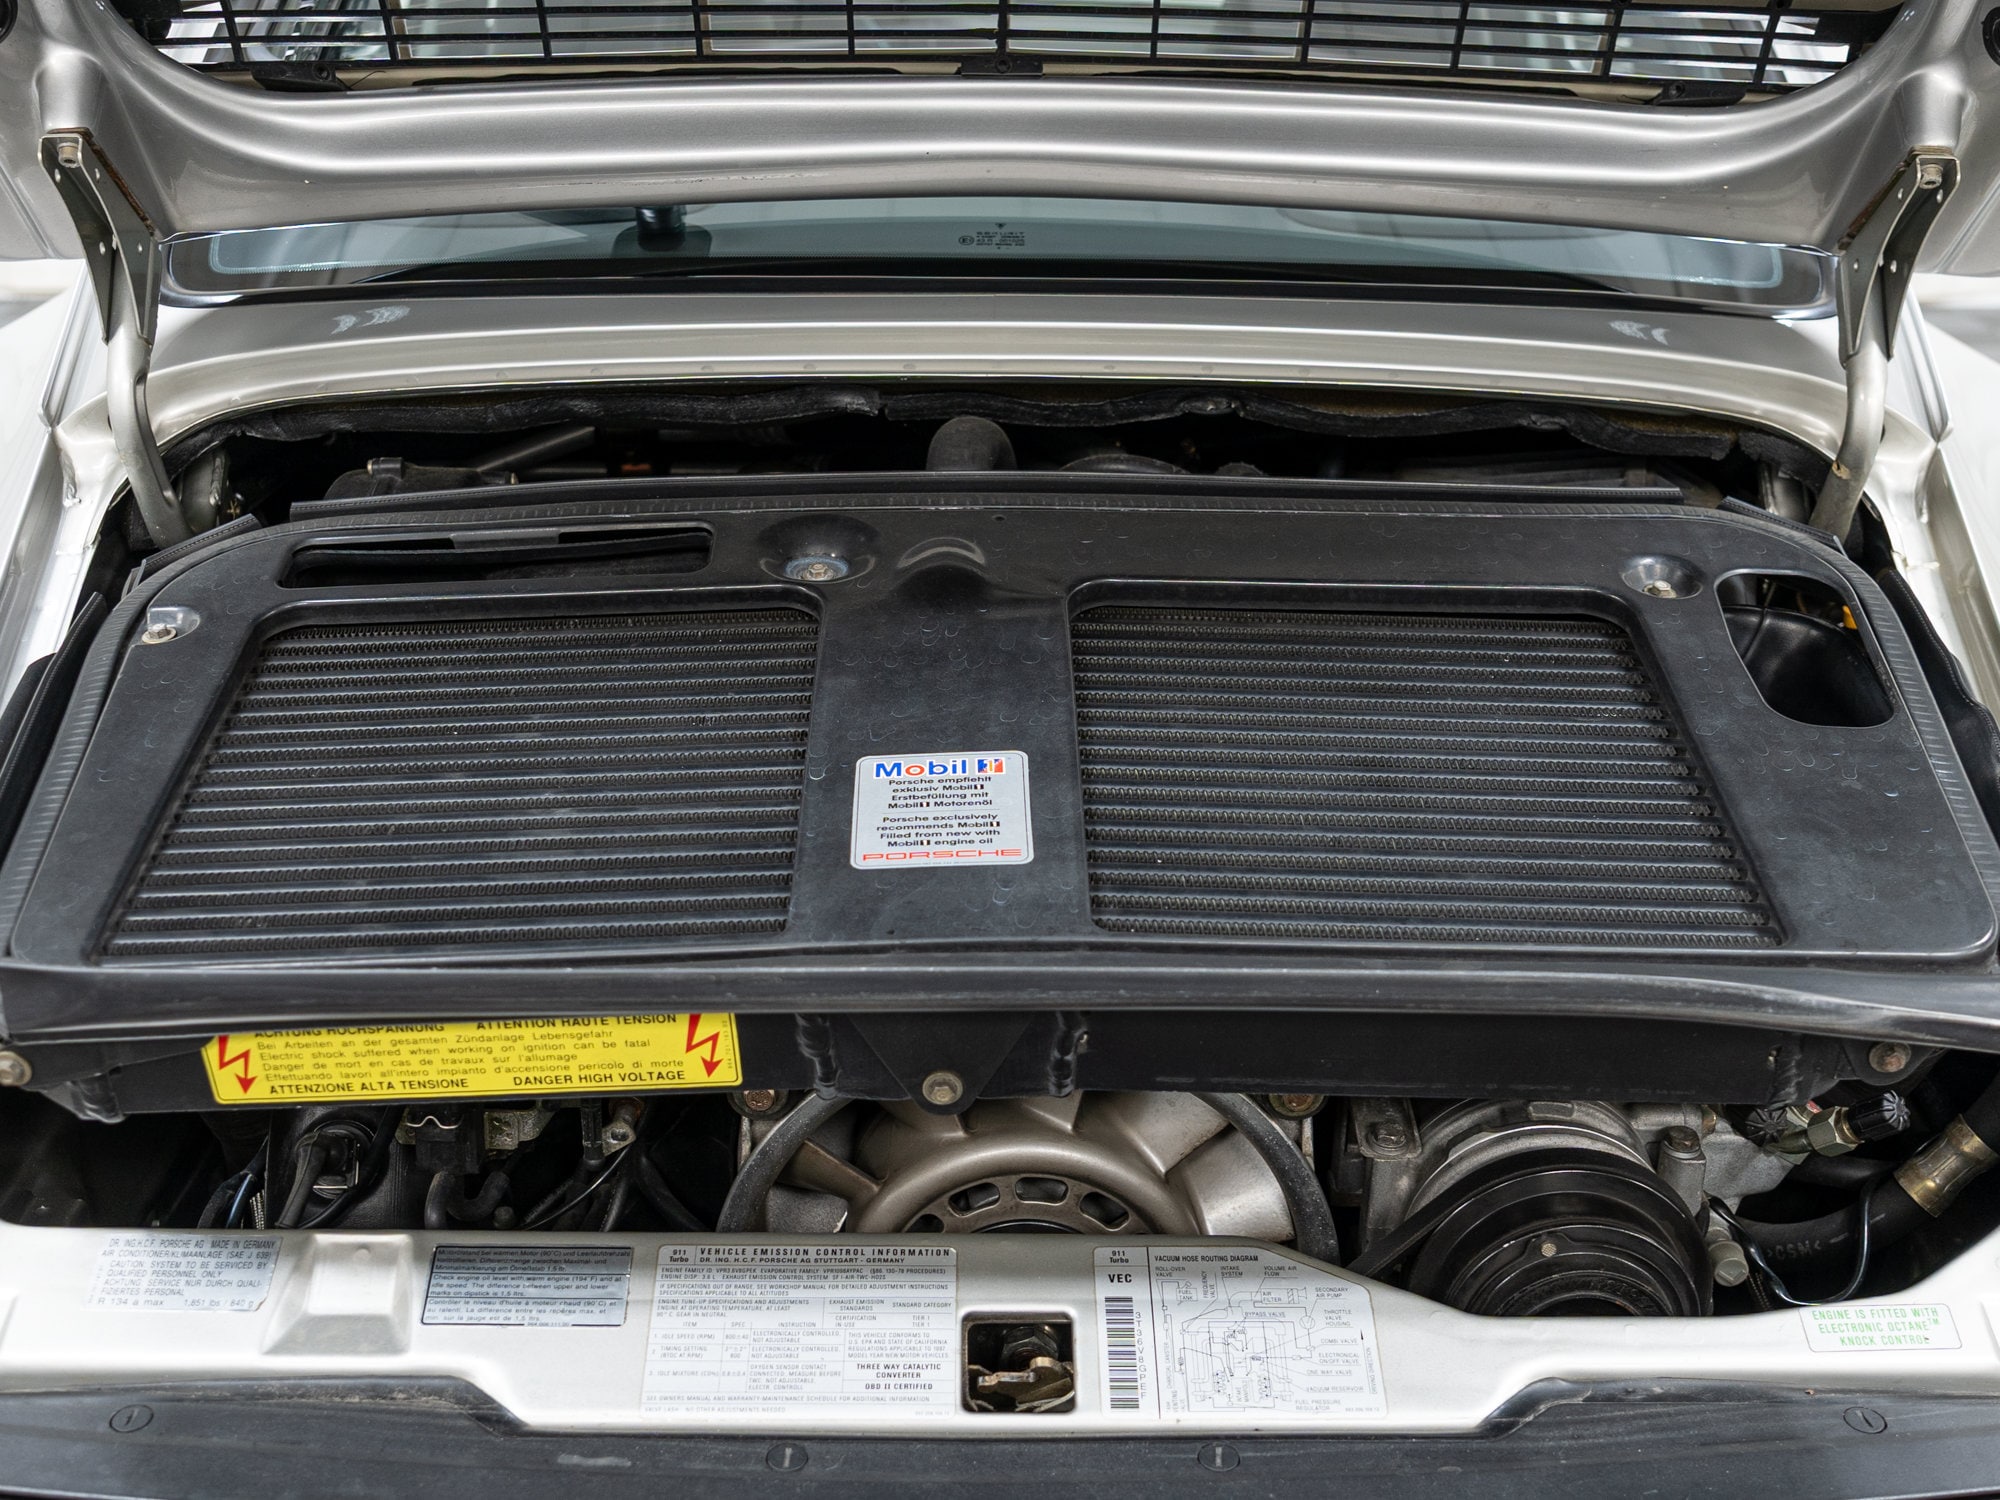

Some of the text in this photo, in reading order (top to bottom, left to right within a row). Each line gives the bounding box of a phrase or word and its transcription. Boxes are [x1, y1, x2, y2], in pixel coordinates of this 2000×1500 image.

[876, 760, 966, 778] Mobil
[892, 792, 966, 801] Erstbefüllung
[877, 823, 953, 831] recommends
[863, 849, 1022, 861] PORSCHE
[477, 1014, 676, 1030] ATTENTION HAUTE TENSION
[258, 1042, 276, 1050] Bei
[285, 1040, 333, 1049] Arbeiten
[364, 1038, 381, 1046] der
[390, 1037, 447, 1047] gesamten
[456, 1034, 525, 1043] Zündanlage
[533, 1030, 613, 1040] Lebensgefahr
[260, 1052, 303, 1061] Electric
[354, 1049, 401, 1057] suffered
[448, 1046, 493, 1054] working
[524, 1044, 565, 1052] ignition
[625, 1039, 650, 1047] fatal
[263, 1063, 304, 1072] Danger
[519, 1054, 577, 1062] l'allumage
[266, 1072, 333, 1082] Effettuando
[381, 1069, 429, 1077] all'intero
[437, 1068, 486, 1076] impianto
[494, 1064, 570, 1073] d'accensione
[578, 1061, 624, 1072] pericolo
[513, 1070, 685, 1086] DANGER HIGH VOLTAGE
[271, 1079, 468, 1094] ATTENZIONE ALTA TENSIONE
[226, 1251, 244, 1259] (SAE
[107, 1269, 147, 1277] QUALIFIED
[1108, 1274, 1132, 1283] VEC
[1812, 1308, 1938, 1320] ENGINE IS FITTED WITH
[1818, 1323, 1882, 1334] ELECTRONIC
[1840, 1335, 1930, 1346] KNOCK CONTROL
